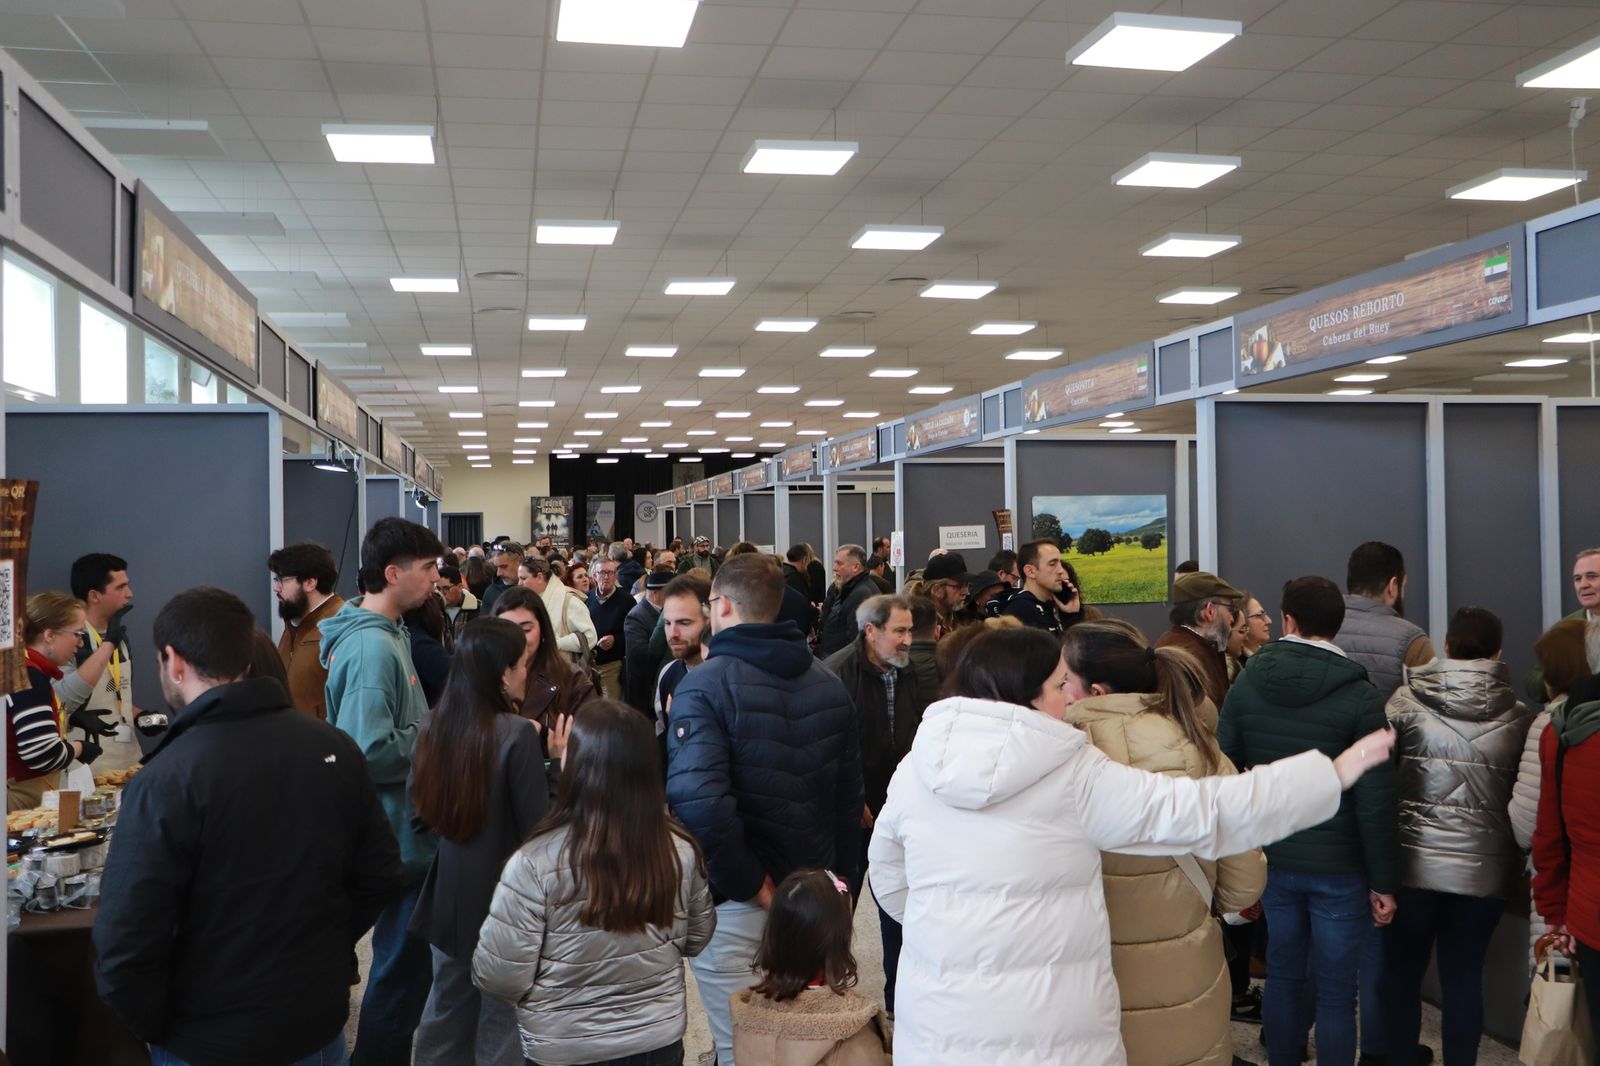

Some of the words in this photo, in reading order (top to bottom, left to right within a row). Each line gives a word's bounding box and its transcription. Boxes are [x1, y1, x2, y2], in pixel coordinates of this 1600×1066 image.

[1309, 307, 1349, 332] QUESOS
[1352, 292, 1405, 319] REBORTO
[1322, 332, 1350, 346] Cabeza
[1353, 327, 1366, 340] del
[1369, 320, 1390, 335] Buey
[11, 486, 25, 499] QR
[946, 530, 978, 539] QUESERIA
